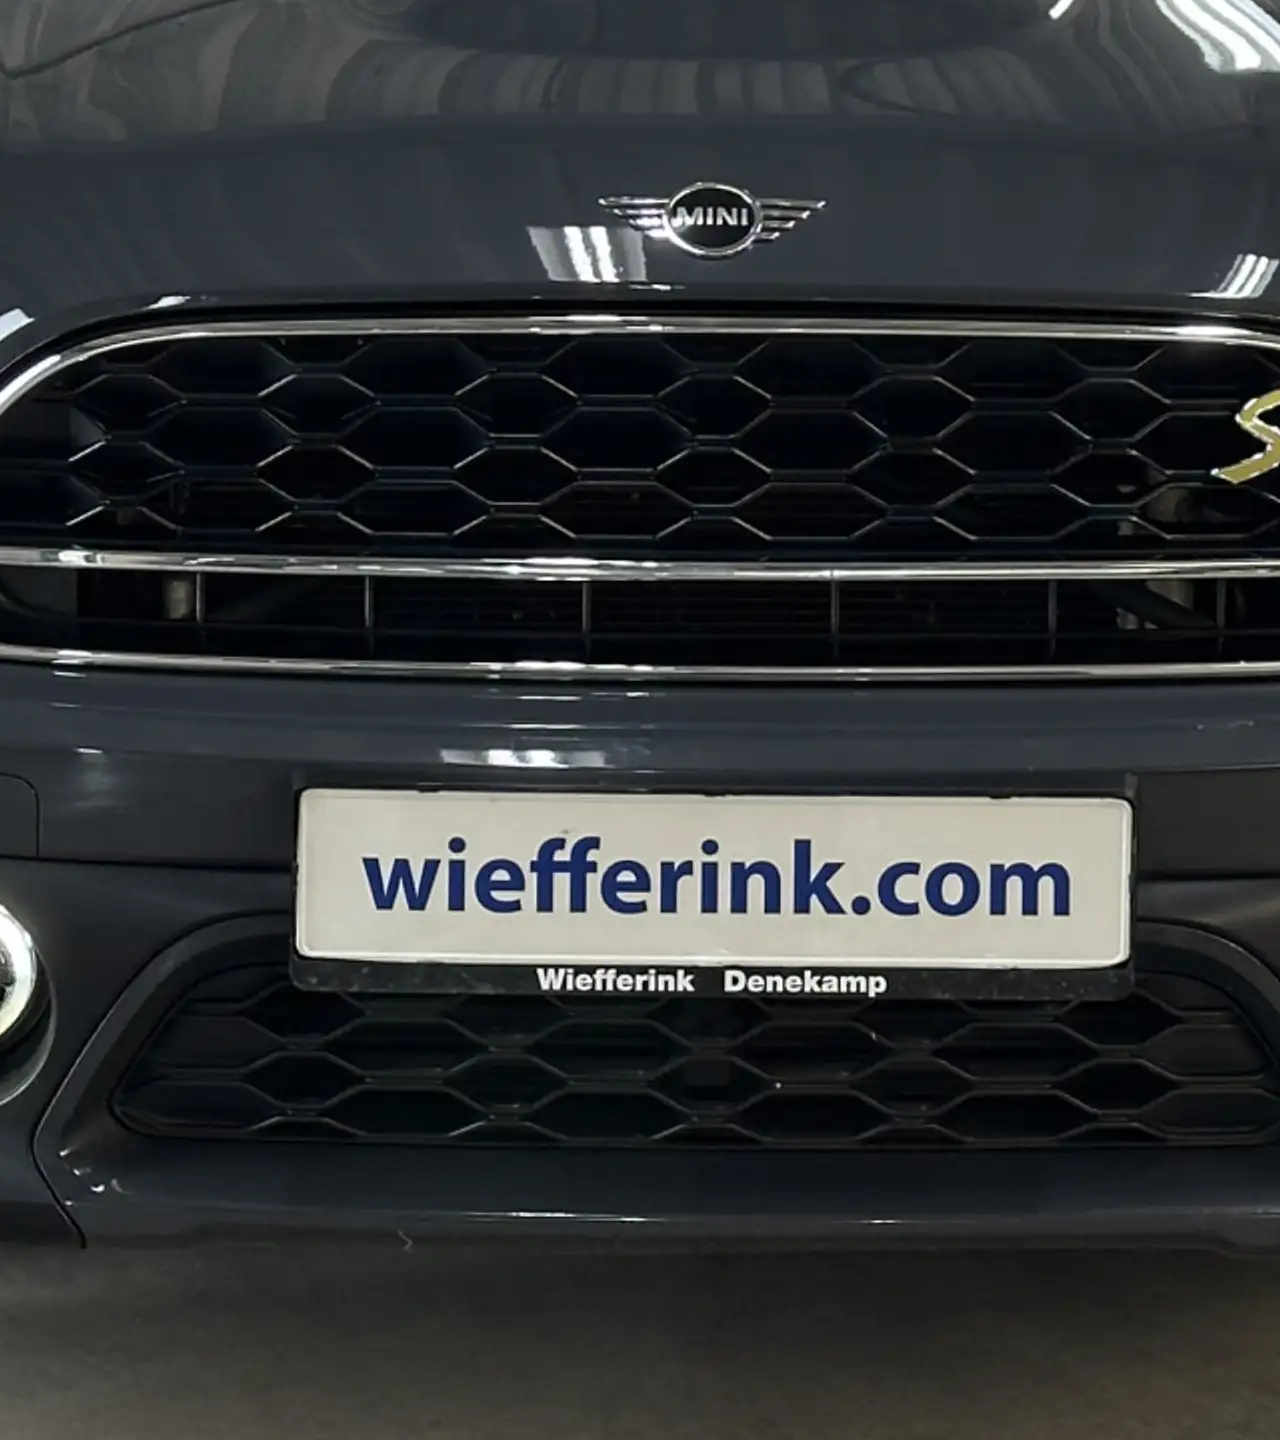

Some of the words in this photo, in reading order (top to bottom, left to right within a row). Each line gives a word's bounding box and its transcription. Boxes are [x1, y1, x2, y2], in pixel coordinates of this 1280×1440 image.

[673, 206, 748, 226] MINI
[363, 836, 1071, 916] wiefferink.com
[536, 967, 694, 992] Wiefferink
[724, 969, 886, 997] Denekamp
